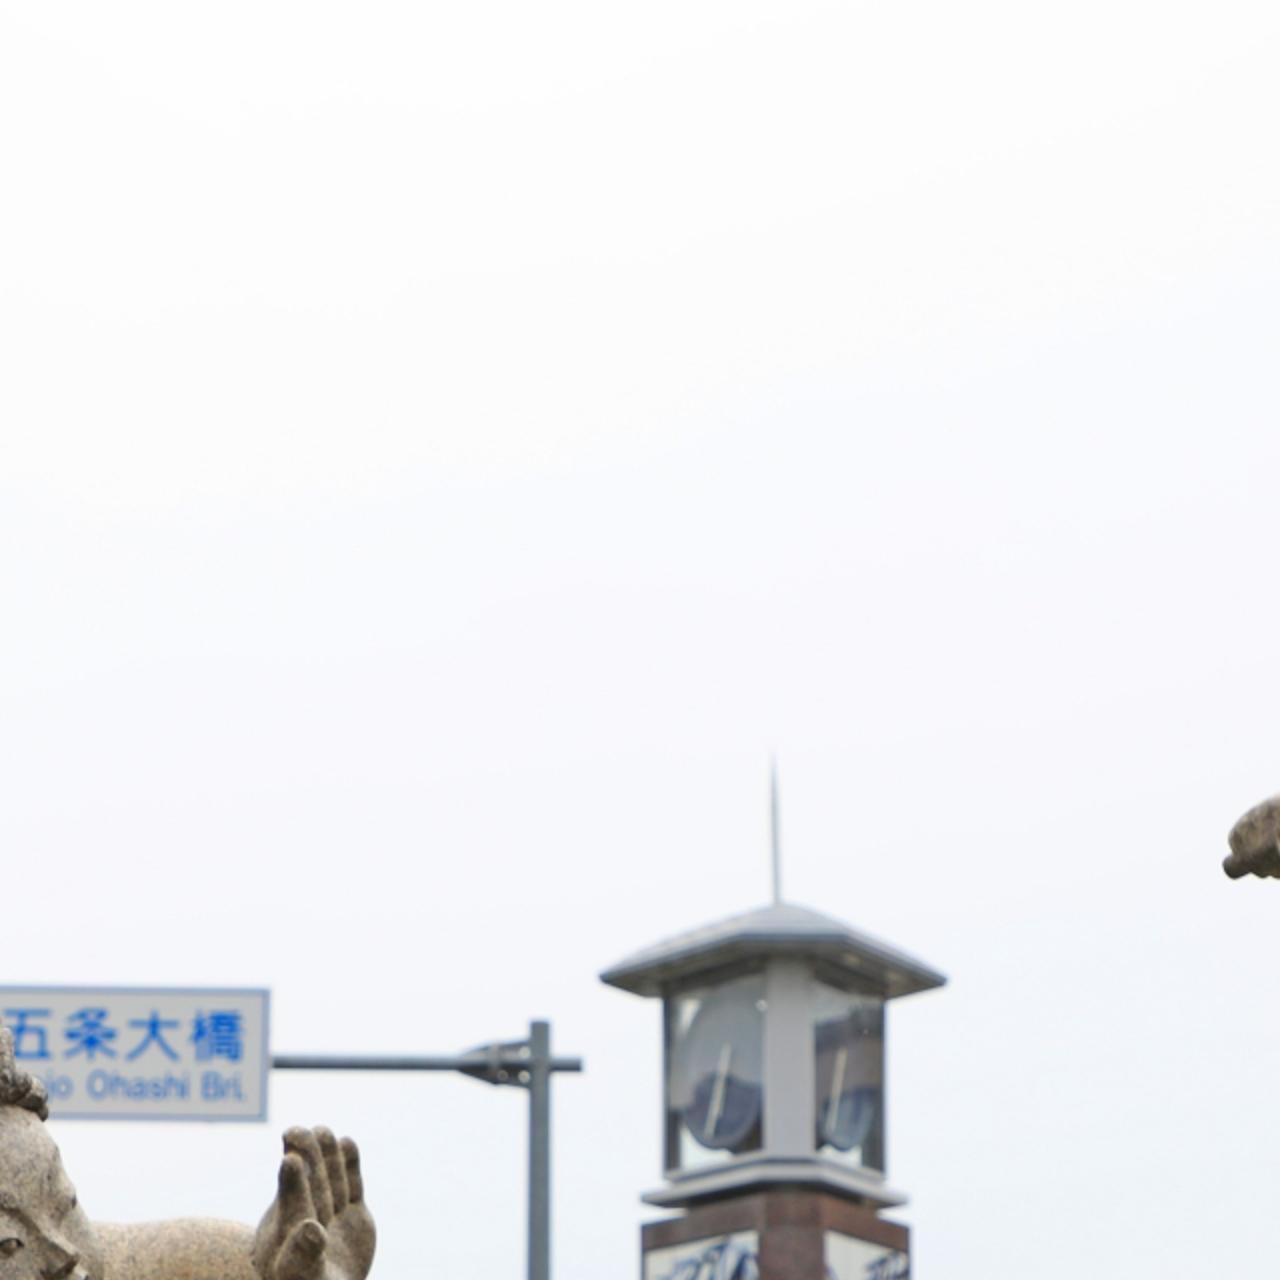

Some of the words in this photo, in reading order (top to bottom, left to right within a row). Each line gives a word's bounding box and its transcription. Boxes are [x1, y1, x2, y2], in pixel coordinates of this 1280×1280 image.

[4, 1008, 244, 1062] 五条大橋
[86, 1068, 189, 1099] Ohashi
